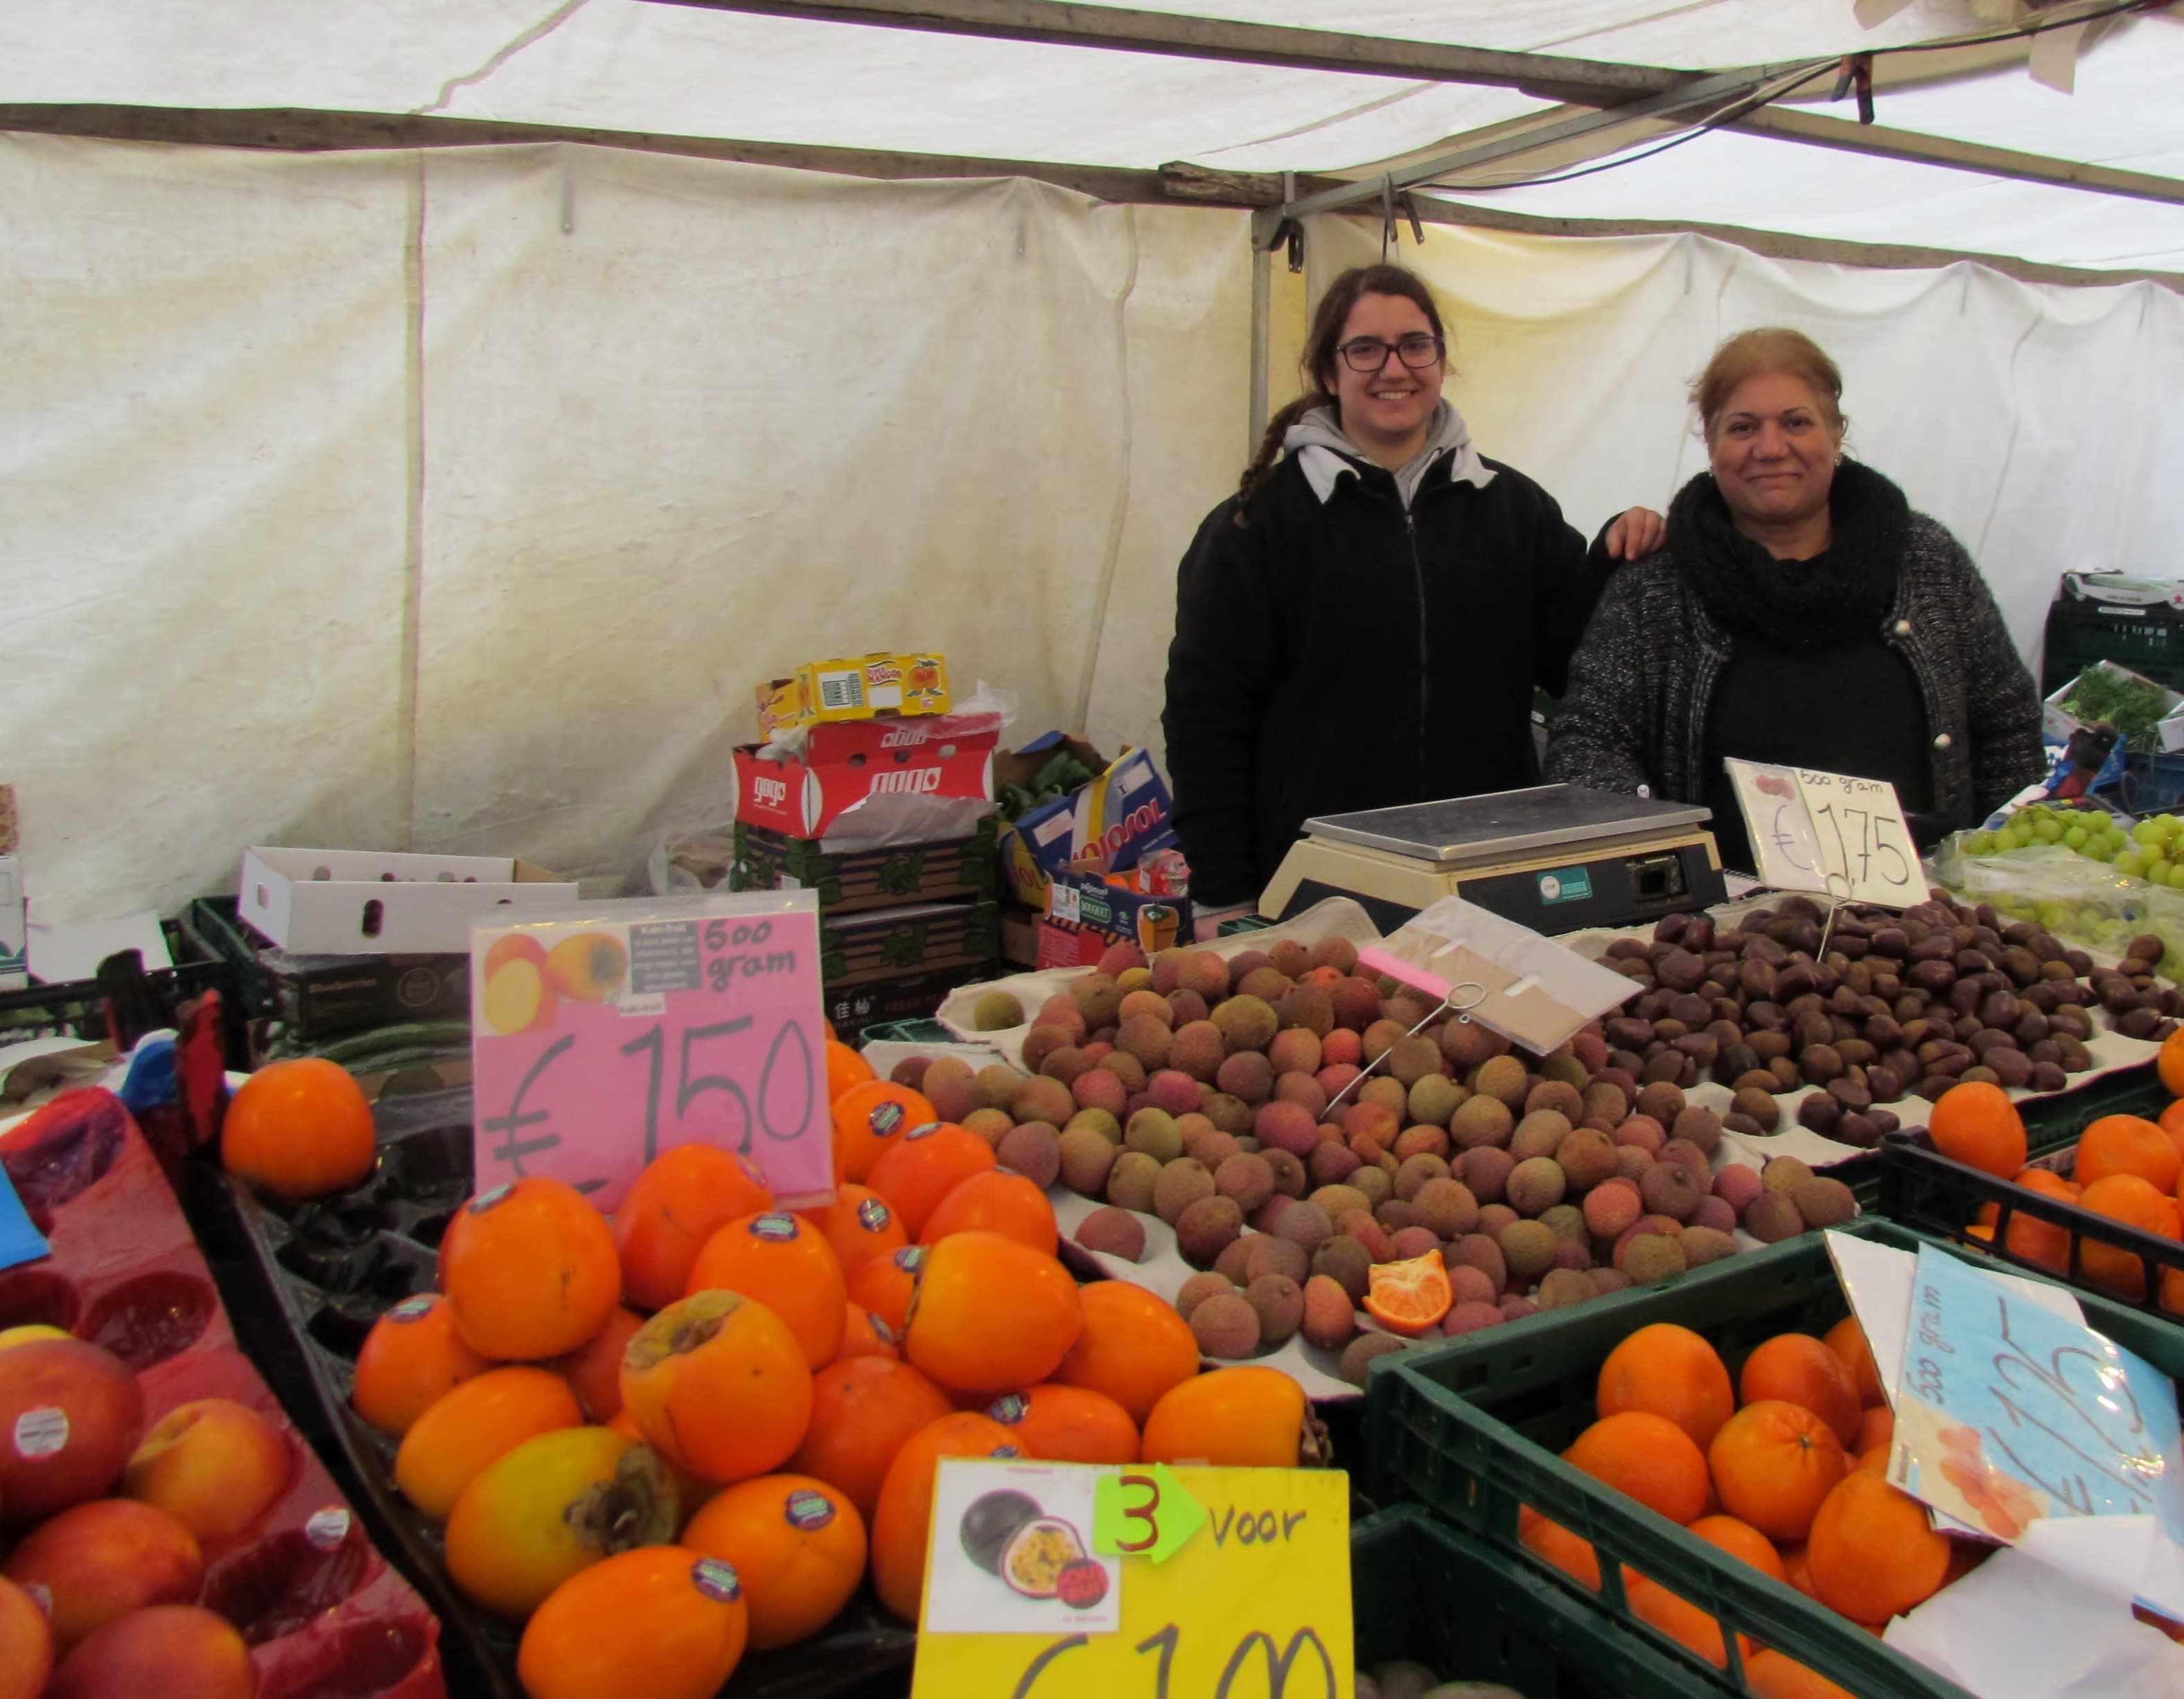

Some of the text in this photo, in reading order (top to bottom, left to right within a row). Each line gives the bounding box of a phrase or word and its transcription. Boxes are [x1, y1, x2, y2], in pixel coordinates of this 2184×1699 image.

[754, 776, 787, 807] gogo
[1799, 769, 1884, 794] 500 gram
[1770, 802, 1910, 887] € 1,75
[705, 919, 773, 951] 500
[707, 950, 796, 992] gram
[1906, 1285, 1955, 1405] 500 gram
[1116, 1475, 1160, 1552] 3
